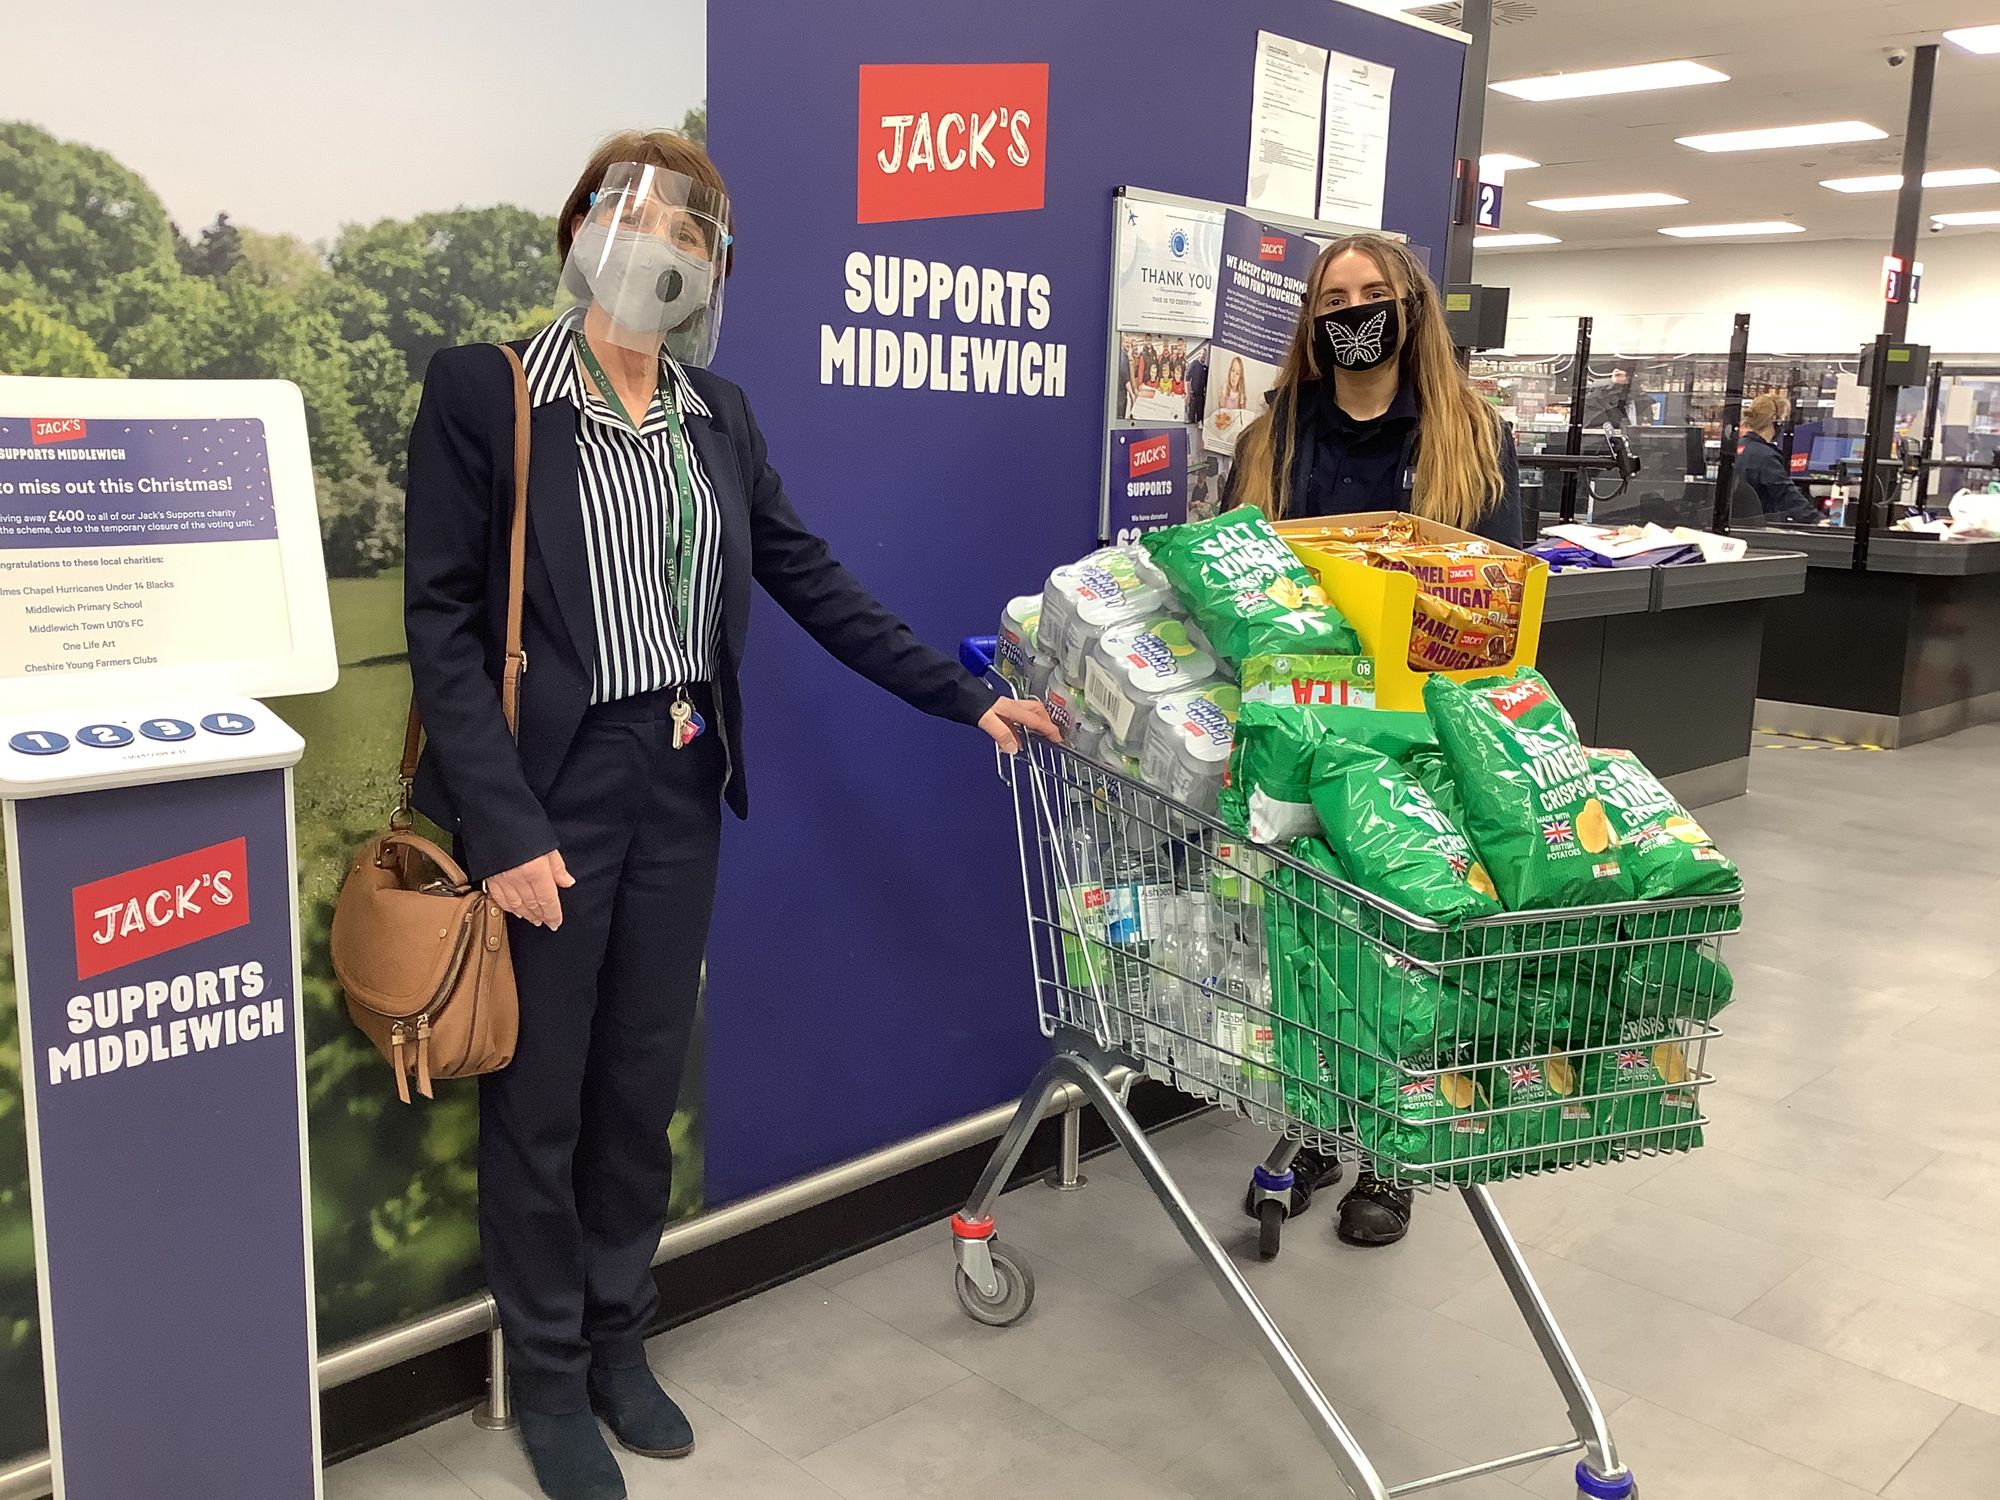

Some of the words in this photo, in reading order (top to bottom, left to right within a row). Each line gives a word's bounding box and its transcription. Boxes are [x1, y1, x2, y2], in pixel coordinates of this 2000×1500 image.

[876, 107, 1030, 174] JACK'S
[1479, 186, 1494, 225] 2
[1261, 243, 1283, 255] JACK'S
[1226, 254, 1238, 269] WE
[1238, 259, 1261, 279] ACCEPT
[1261, 269, 1282, 286] COVID
[1141, 268, 1184, 287] THANK
[1188, 273, 1212, 289] YOU
[844, 251, 1051, 330] SUPPORTS
[1233, 272, 1249, 289] FOOD
[1250, 279, 1266, 296] FUND
[1267, 285, 1302, 307] VOUCHERS
[820, 324, 1067, 397] MIDDLEWICH
[661, 390, 674, 415] STAFF
[37, 419, 81, 435] JACK'S
[0, 448, 55, 460] SUPPORTS
[57, 449, 126, 461] MIDDLEWICH
[1133, 445, 1167, 467] JACK'S
[19, 479, 61, 494] miss
[65, 479, 95, 494] out
[99, 478, 134, 493] this
[138, 476, 232, 493] Christmas!
[1127, 481, 1172, 497] SUPPORTS
[24, 514, 46, 524] away
[49, 509, 85, 522] £400
[87, 513, 96, 521] to
[98, 511, 108, 520] all
[110, 511, 119, 520] of
[121, 512, 135, 520] our
[138, 511, 164, 520] Jack's
[166, 509, 205, 520] Supports
[207, 508, 236, 519] charity
[0, 526, 15, 534] the
[17, 525, 52, 535] scheme,
[54, 524, 71, 533] due
[73, 525, 82, 533] to
[84, 525, 99, 533] the
[101, 523, 146, 533] temporary
[148, 522, 178, 531] closure
[181, 521, 189, 530] of
[191, 521, 205, 530] the
[207, 520, 234, 530] voting
[236, 519, 255, 528] unit.
[1200, 522, 1258, 557] SALT
[1255, 519, 1277, 537] &
[62, 560, 72, 568] to
[74, 558, 98, 567] these
[101, 557, 121, 566] local
[124, 555, 164, 566] charities:
[1449, 568, 1474, 579] JACK'S
[23, 585, 54, 597] Chapel
[56, 583, 104, 594] Hurricanes
[106, 582, 132, 592] Under
[134, 581, 144, 590] 14
[146, 580, 175, 590] Blacks
[25, 603, 75, 614] Middlewich
[77, 602, 111, 613] Primary
[113, 600, 143, 610] School
[29, 622, 79, 633] Middlewich
[81, 621, 105, 631] Town
[106, 620, 130, 630] U10's
[131, 619, 144, 628] FC
[1413, 609, 1459, 644] RAMEL
[63, 642, 81, 651] One
[83, 640, 100, 650] Life
[102, 640, 116, 648] Art
[24, 662, 65, 673] Cheshire
[66, 660, 94, 671] Young
[96, 658, 131, 667] Farmers
[132, 655, 158, 665] Clubs
[1356, 663, 1371, 676] 80
[154, 722, 181, 736] 3
[216, 715, 243, 729] 4
[26, 734, 52, 748] 1
[91, 727, 120, 743] 2
[1539, 777, 1587, 812] CRISPS
[1536, 815, 1553, 824] MADE
[1554, 811, 1570, 821] WITH
[1550, 841, 1575, 852] BRITISH
[1547, 849, 1581, 861] POTATOES
[92, 870, 234, 945] JACK'S
[66, 961, 264, 1034] SUPPORTS
[48, 998, 284, 1085] MIDDLEWICH
